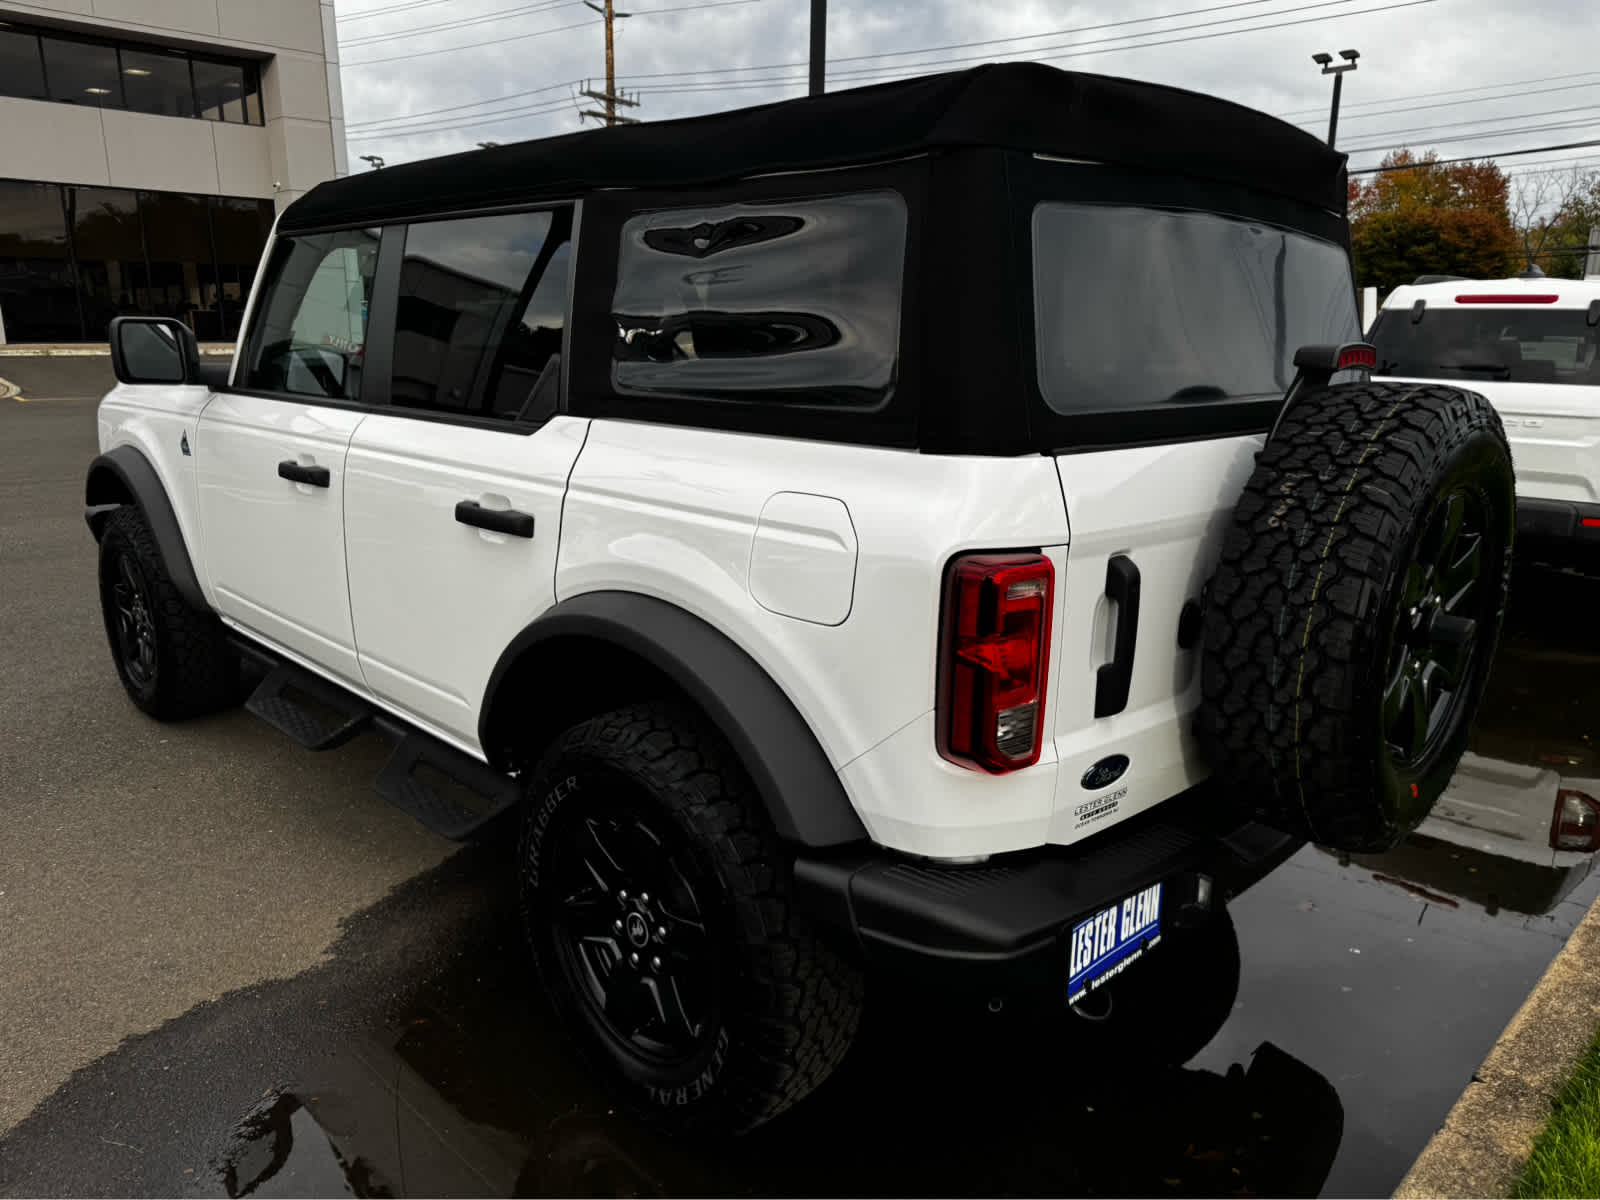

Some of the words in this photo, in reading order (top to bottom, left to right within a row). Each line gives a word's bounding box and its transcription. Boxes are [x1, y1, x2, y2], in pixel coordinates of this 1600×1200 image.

[1074, 798, 1102, 816] LESTER
[1069, 904, 1118, 978] LESTER
[1120, 882, 1161, 942] GLENN
[646, 1024, 729, 1105] GENERAL
